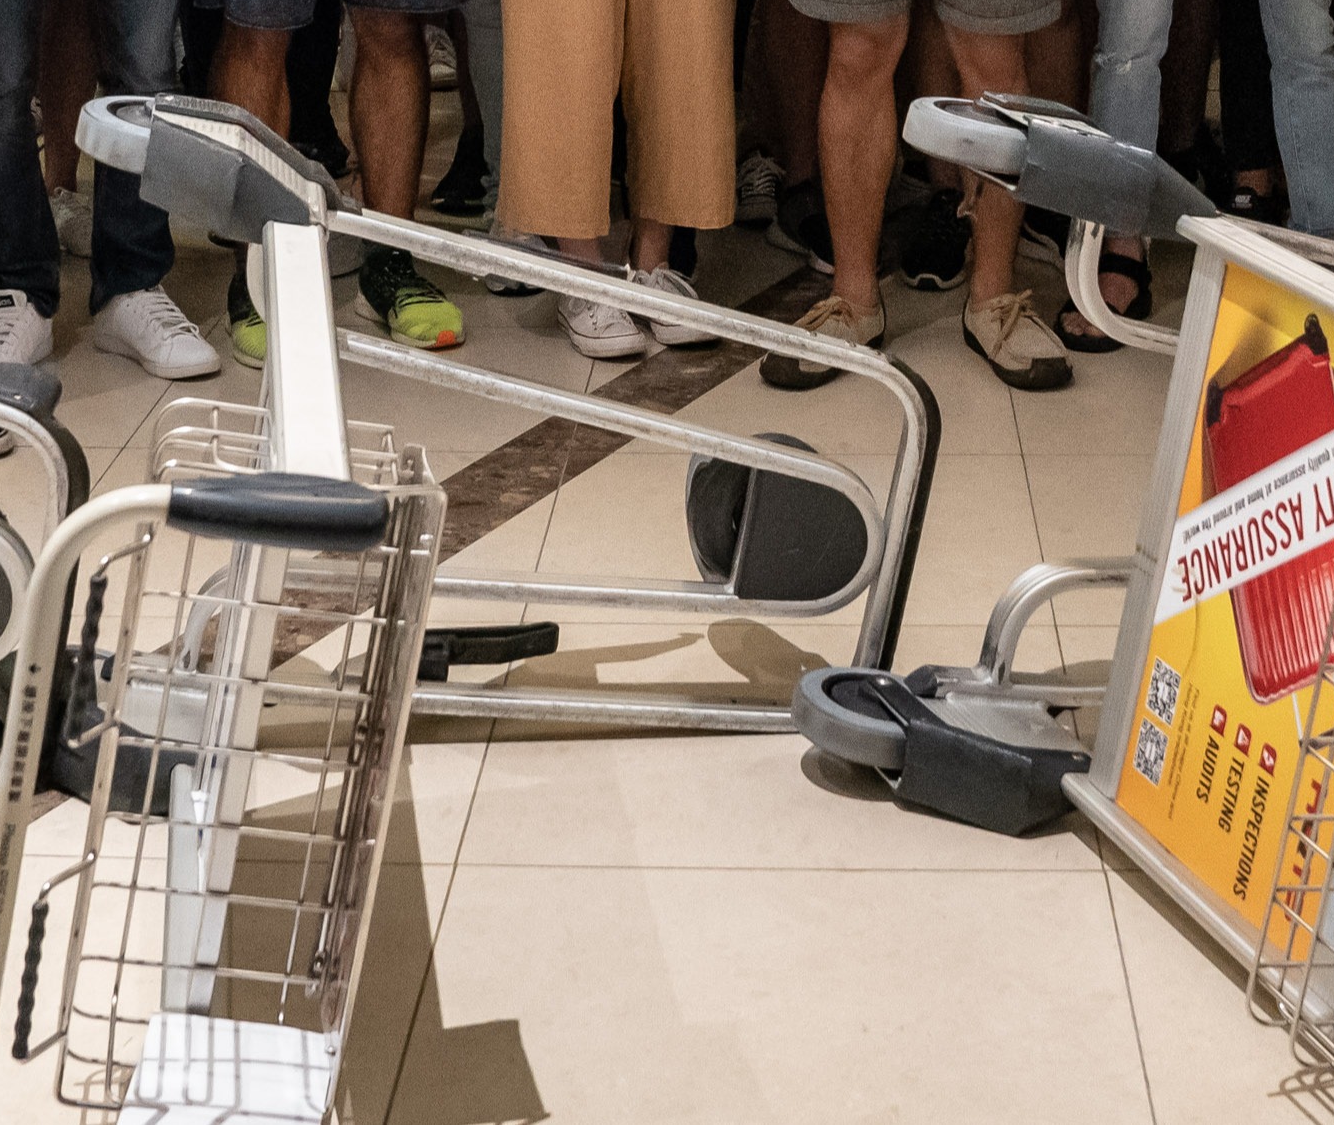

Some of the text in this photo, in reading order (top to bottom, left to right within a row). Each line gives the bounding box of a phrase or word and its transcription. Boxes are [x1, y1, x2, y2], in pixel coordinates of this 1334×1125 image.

[1307, 448, 1330, 472] quality
[1273, 464, 1307, 488] assurance
[1247, 486, 1265, 506] home
[1265, 482, 1273, 495] at
[1212, 501, 1235, 521] around
[1233, 496, 1247, 515] and
[1201, 512, 1213, 530] the
[1177, 491, 1305, 603] ASSURANCE
[1195, 735, 1221, 805] AUDITS
[1217, 757, 1246, 836] TESTING
[1232, 775, 1271, 901] INSPECTIONS
